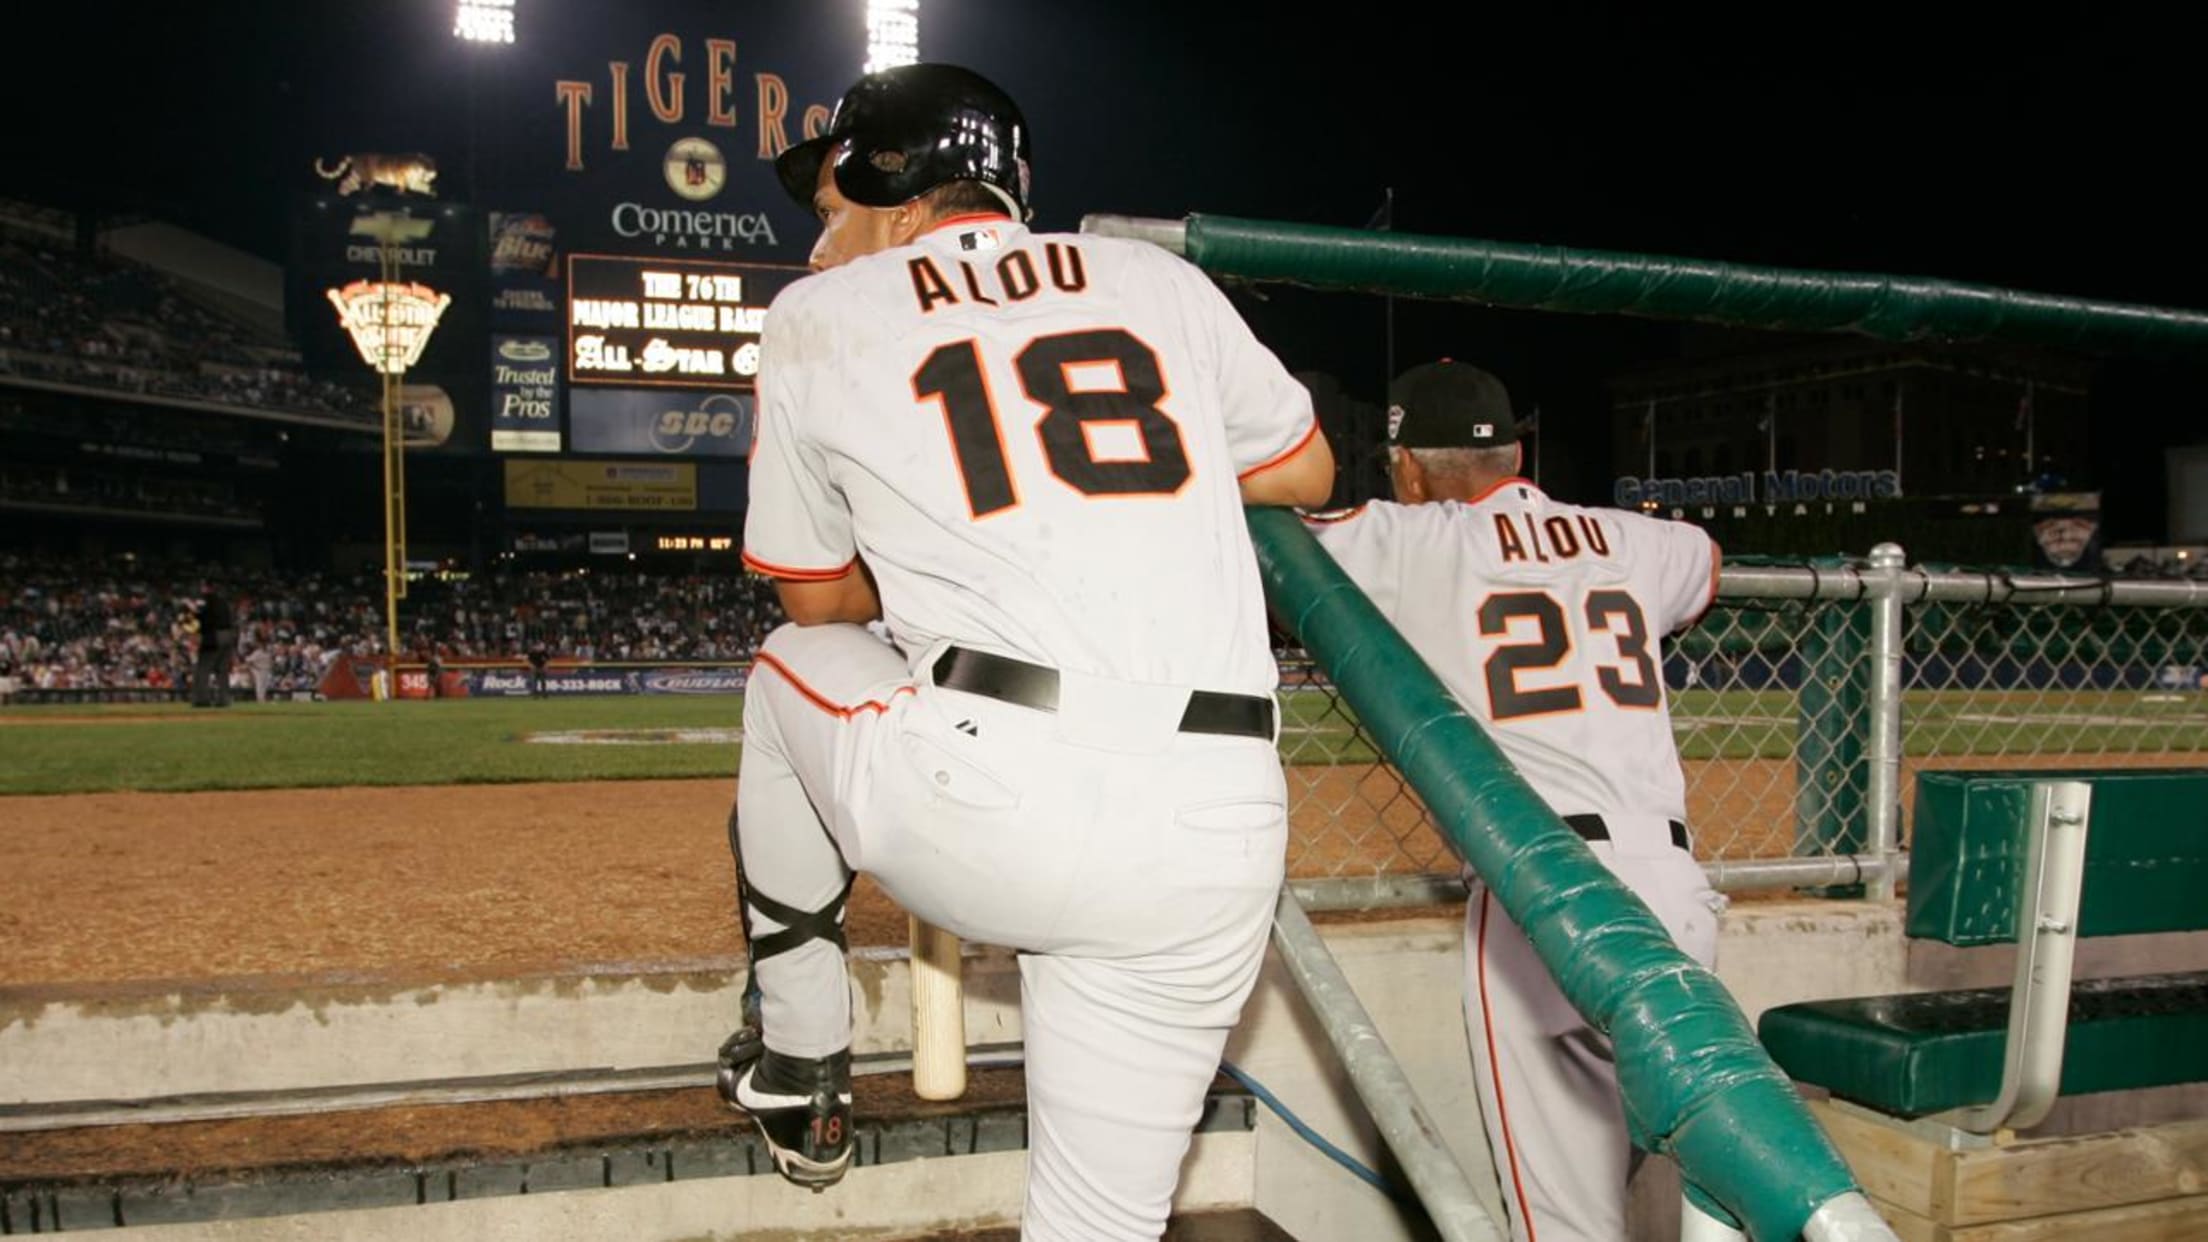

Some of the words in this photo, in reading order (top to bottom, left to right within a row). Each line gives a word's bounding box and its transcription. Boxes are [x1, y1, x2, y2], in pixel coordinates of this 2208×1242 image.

[656, 233, 734, 250] PARK
[642, 272, 682, 299] THE
[686, 275, 741, 302] 76TH
[907, 242, 1087, 314] ALOU
[573, 300, 639, 329] MAJOR
[643, 303, 716, 331] LEAGUE
[496, 366, 556, 385] Trusted
[502, 394, 551, 418] Pros
[520, 386, 535, 400] by
[536, 386, 554, 398] the
[659, 411, 735, 437] SBC
[910, 326, 1195, 522] 18
[1613, 473, 1755, 508] General
[1764, 467, 1900, 502] Motors
[1492, 511, 1610, 563] ALOU
[1476, 588, 1662, 723] 23
[400, 673, 429, 690] 345
[483, 675, 527, 690] Rock
[811, 1116, 842, 1145] 18
